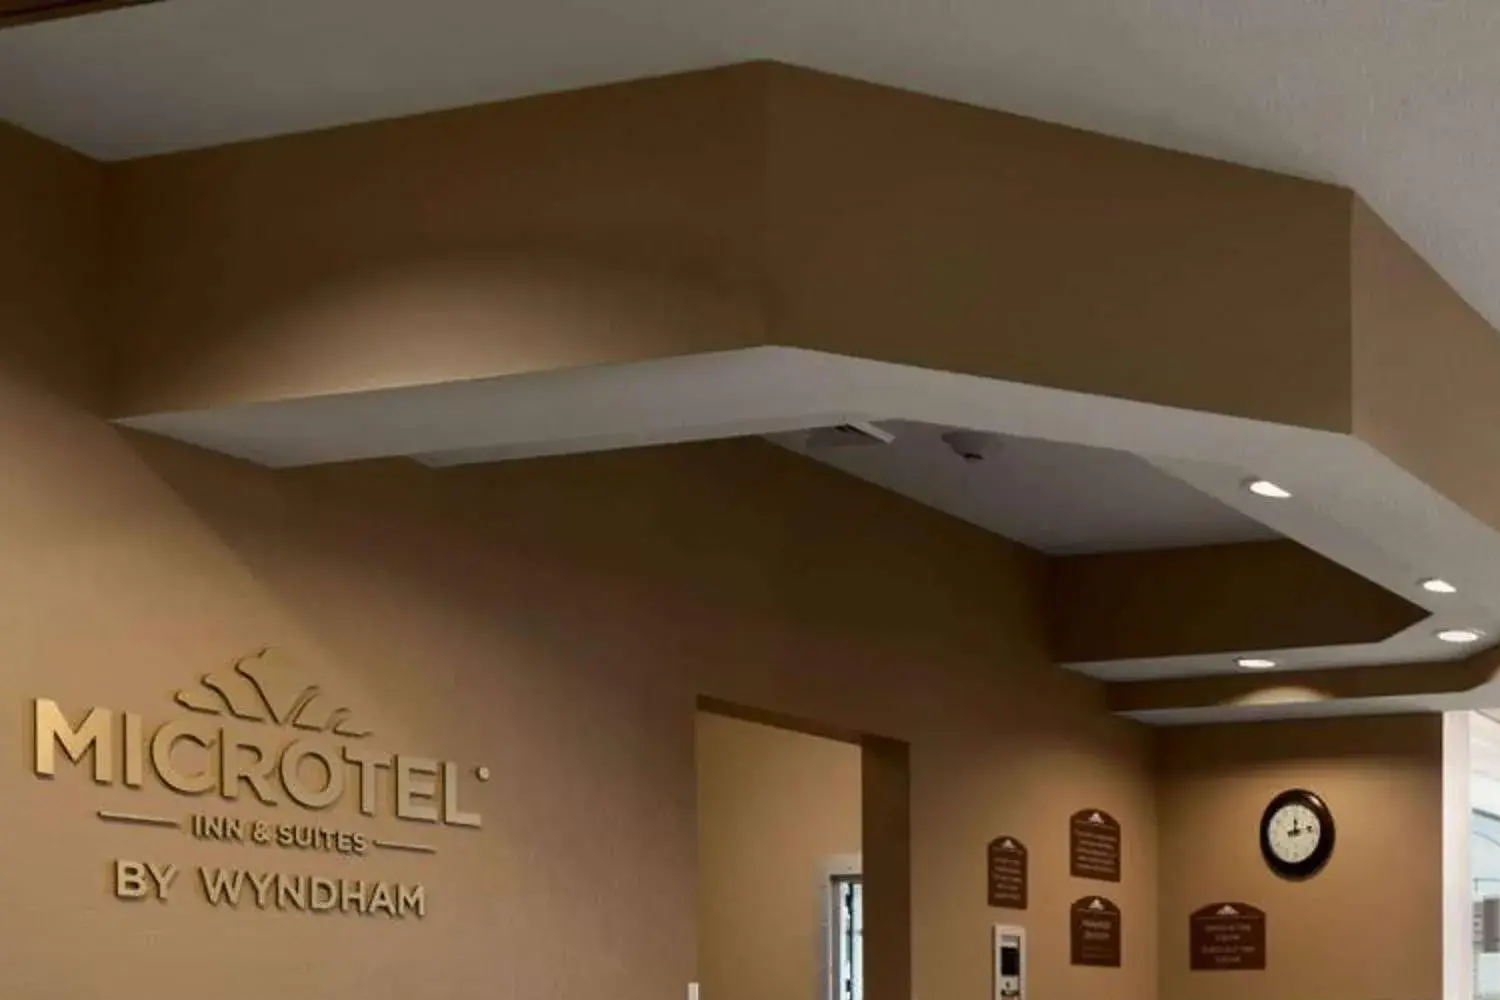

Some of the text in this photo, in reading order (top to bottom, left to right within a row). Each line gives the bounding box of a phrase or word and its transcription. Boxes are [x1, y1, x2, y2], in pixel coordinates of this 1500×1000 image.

[33, 697, 482, 829] MICROTEL
[191, 814, 367, 853] INN & SUITES
[114, 858, 426, 918] BY WYNDHAM
